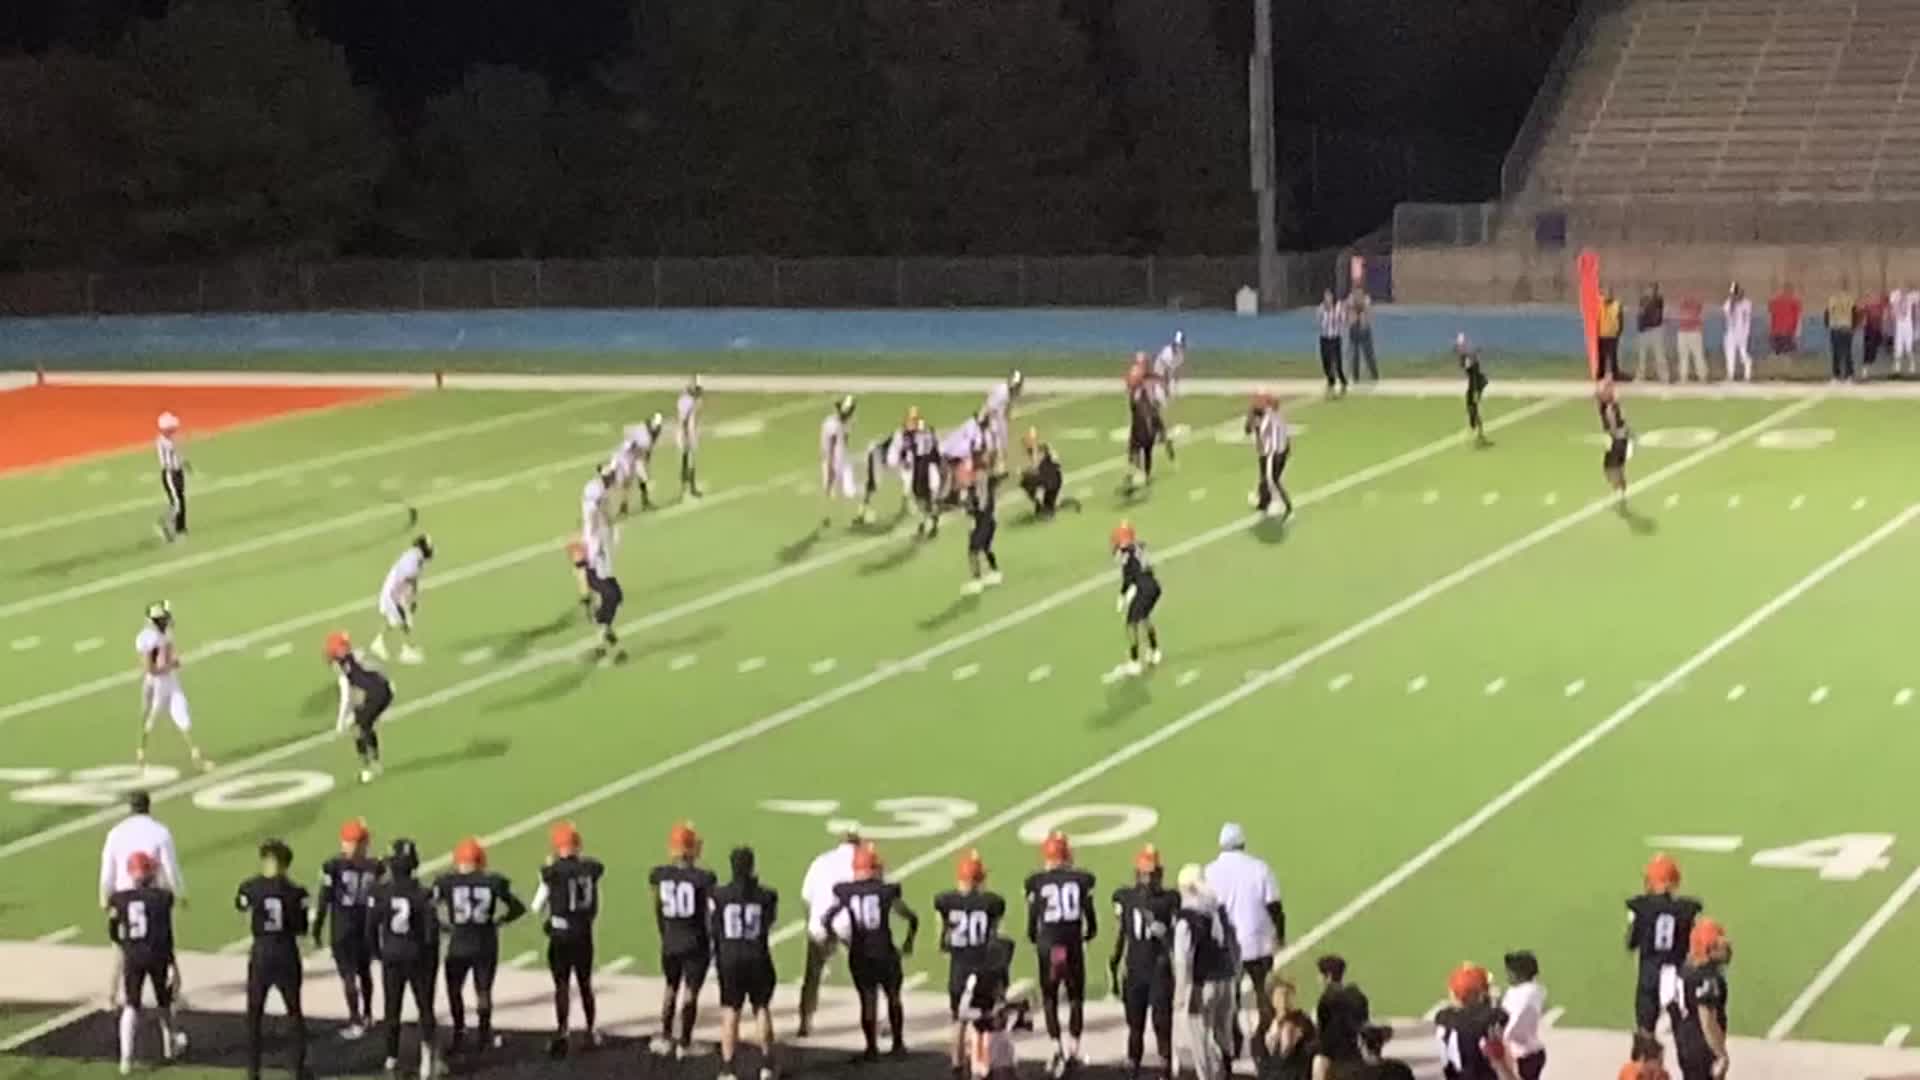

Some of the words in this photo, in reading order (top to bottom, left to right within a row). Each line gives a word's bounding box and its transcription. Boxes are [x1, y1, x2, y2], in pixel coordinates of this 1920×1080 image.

[263, 897, 283, 931] 3
[390, 897, 410, 934] 2
[453, 885, 491, 924] 52
[660, 880, 695, 918] 50
[1041, 882, 1080, 922] 30
[127, 900, 147, 939] 5
[949, 910, 988, 946] 20
[1655, 913, 1675, 950] 8
